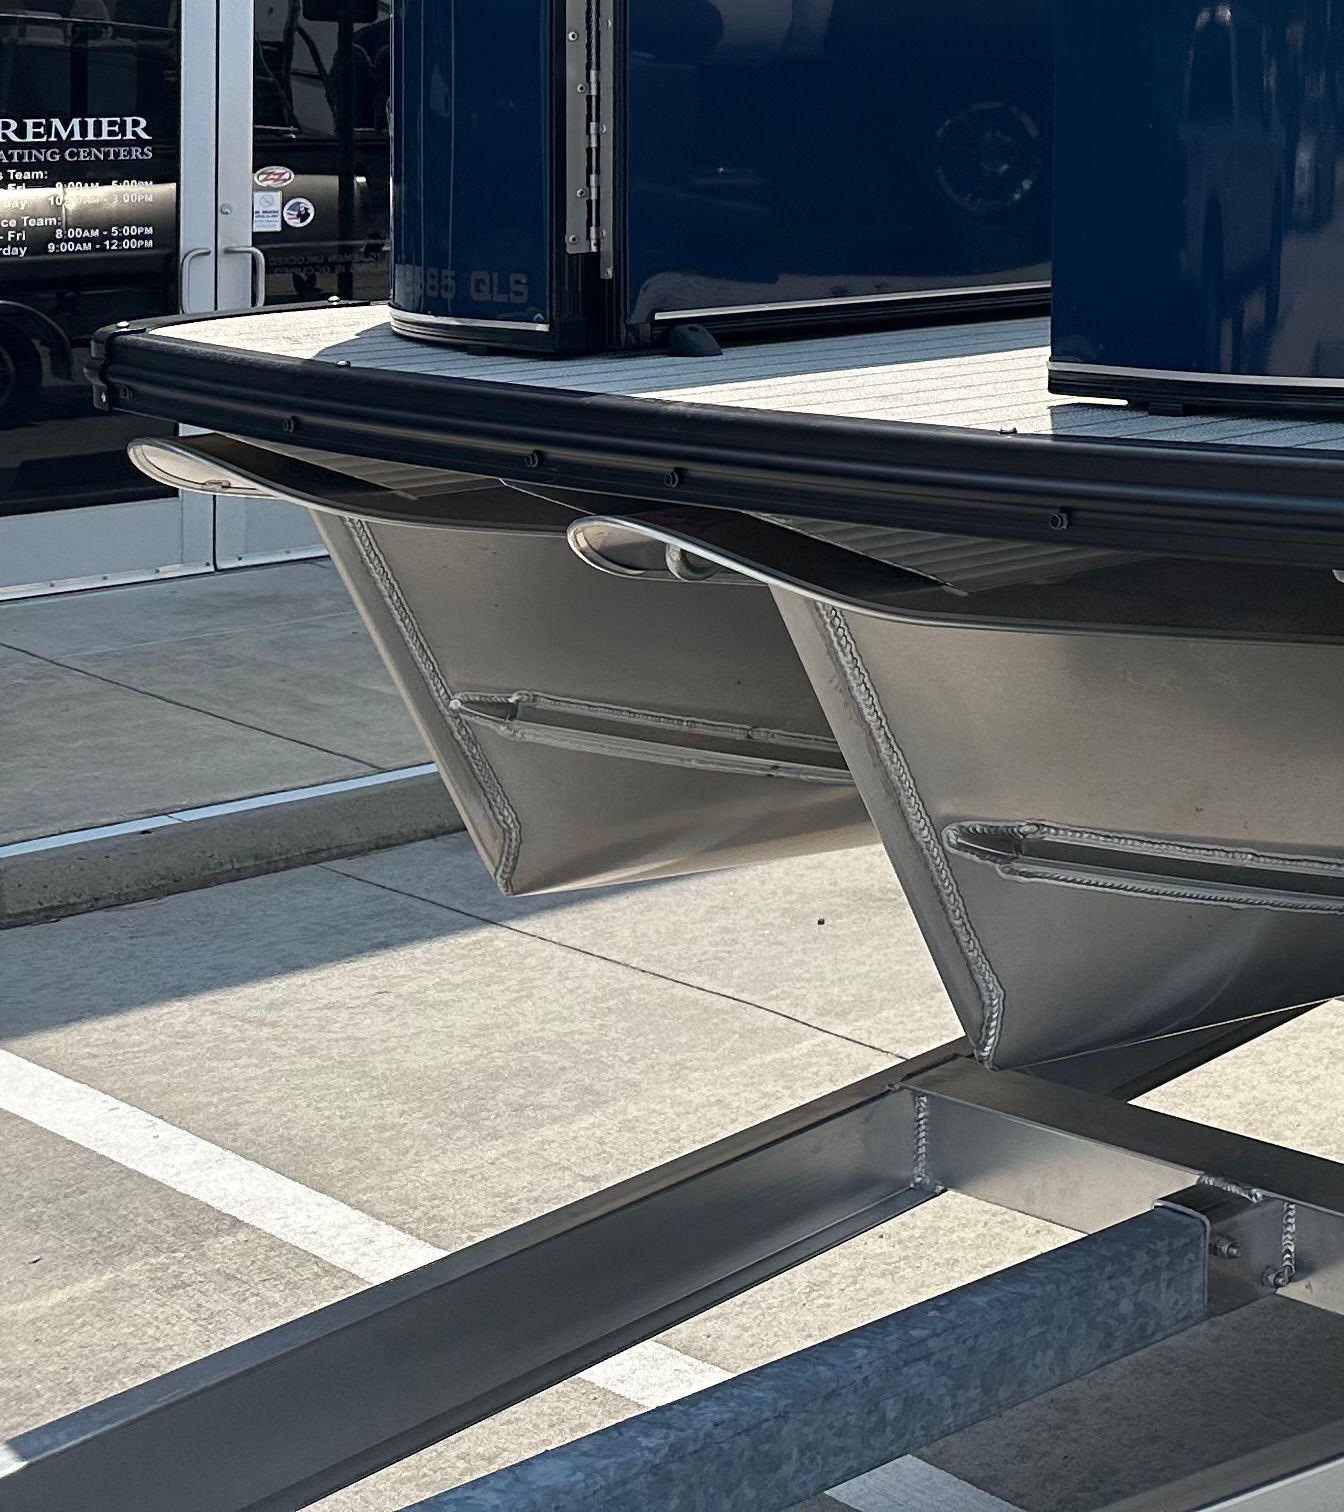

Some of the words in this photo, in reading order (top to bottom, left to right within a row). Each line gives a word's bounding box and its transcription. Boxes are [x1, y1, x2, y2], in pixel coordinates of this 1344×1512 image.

[0, 116, 153, 142] REMIER
[64, 146, 153, 162] CENTERS
[7, 169, 48, 180] Team:
[22, 215, 62, 227] Team:
[7, 230, 26, 241] Fri
[55, 227, 100, 239] 8:00AM
[111, 225, 153, 236] 5:00PM
[47, 241, 92, 253] 9:00AM
[103, 238, 153, 250] 12:00PM
[470, 270, 529, 304] QLS
